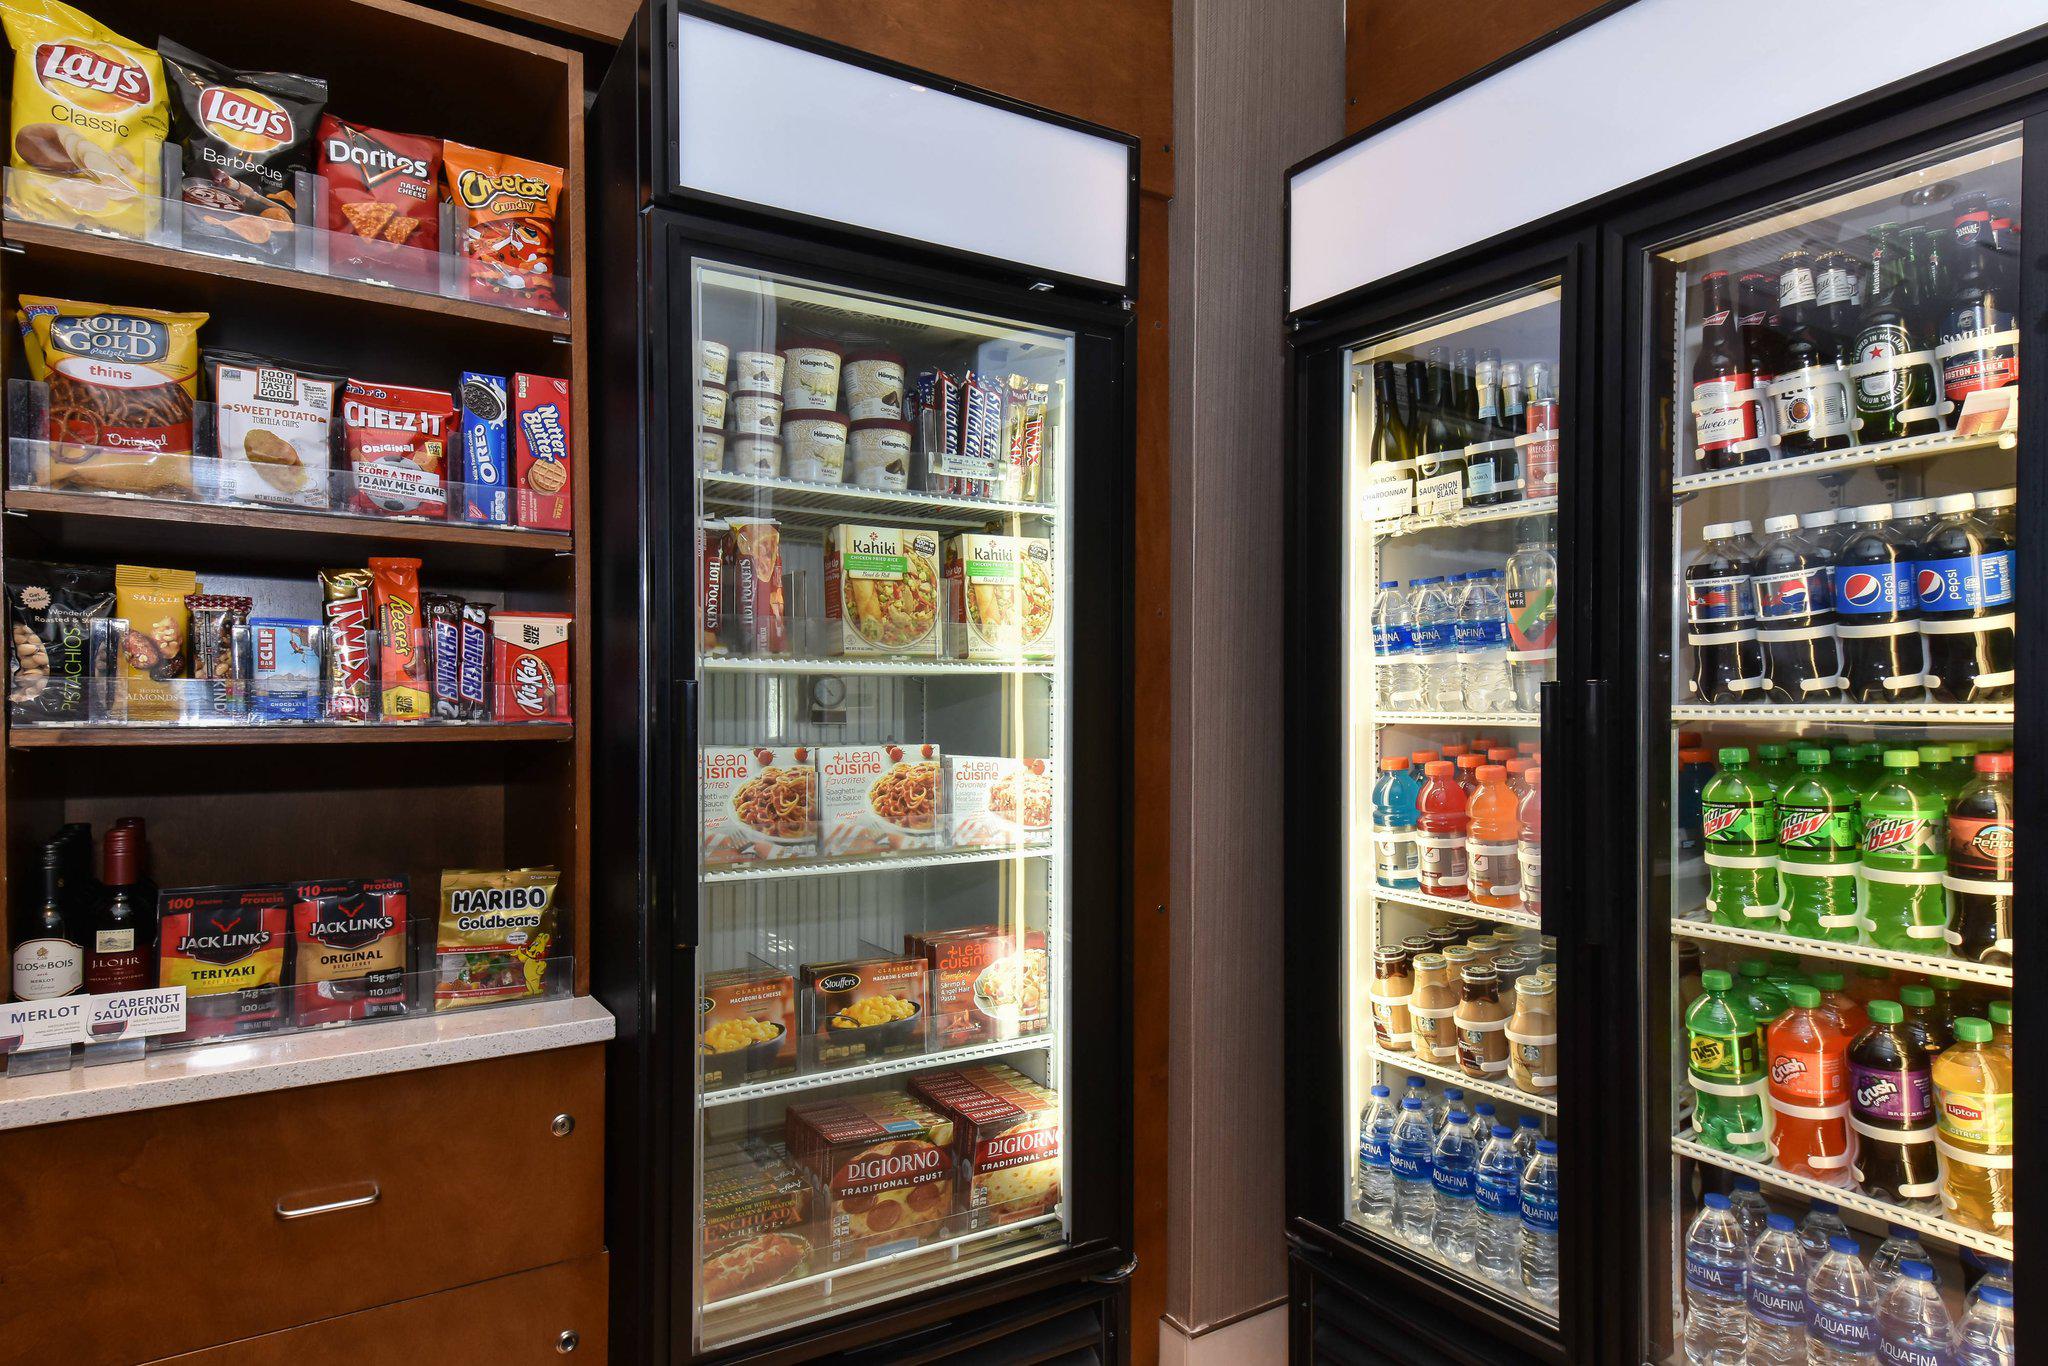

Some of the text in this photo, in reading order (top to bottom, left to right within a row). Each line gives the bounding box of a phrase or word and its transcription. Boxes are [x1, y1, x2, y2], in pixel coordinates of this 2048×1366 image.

[42, 45, 144, 94] Lay's
[51, 104, 130, 138] Classic
[206, 91, 287, 135] Lay's
[203, 147, 283, 181] Barbecue
[329, 140, 428, 178] Doritos
[397, 187, 428, 199] CHEESE
[400, 181, 427, 193] NACHO
[460, 170, 548, 204] Cheetos
[490, 200, 535, 213] Crunchy
[1956, 222, 1981, 234] SAMUEL
[1871, 260, 1881, 295] Heineken
[74, 316, 152, 336] ROLD
[61, 330, 158, 358] GOLD
[1869, 333, 1905, 352] IN HOLLAND
[90, 347, 126, 359] Pretzels
[89, 365, 133, 380] thins
[261, 370, 293, 380] FOOD
[1973, 361, 2006, 376] LAGER
[261, 376, 293, 386] SHOULD
[261, 382, 292, 391] TASTE
[261, 389, 292, 399] GOOD
[374, 390, 386, 399] Go
[808, 396, 828, 404] VANILLA
[234, 404, 317, 423] SWEET POTATO
[344, 401, 443, 436] CHEEZ-IT
[252, 416, 300, 428] TORTILLA CHIPS
[523, 411, 554, 463] Butter
[538, 405, 567, 458] Nutter
[107, 433, 169, 450] Original
[1026, 416, 1044, 466] TWIX
[468, 446, 477, 466] Favorite
[473, 424, 498, 484] OREO
[358, 467, 422, 483] SCORE A TRIP
[358, 475, 445, 497] TO ANY MLS GAME
[1419, 480, 1459, 496] SAUVIGNON
[1437, 488, 1459, 499] BLANC
[1363, 487, 1409, 502] CHARDONNAY
[853, 540, 896, 555] Kahiki
[974, 547, 1014, 561] Kahiki
[1882, 572, 1894, 604] pepsi
[1945, 569, 1962, 601] pepsi
[132, 593, 181, 604] SAHALE
[707, 561, 721, 629] HOT POCKETS
[49, 609, 94, 617] Wonderful
[389, 594, 415, 657] Reese's
[523, 624, 532, 643] KING
[326, 586, 371, 691] TWIX
[531, 625, 540, 645] SIZE
[260, 628, 274, 662] CLIF
[60, 627, 83, 711] PISTACHIOS
[436, 622, 459, 700] SNICKERS
[463, 624, 485, 700] SNICKERS
[127, 693, 179, 701] ALMONDS
[213, 680, 228, 712] KIND
[707, 752, 747, 767] Lean
[845, 751, 881, 764] Lean
[971, 761, 999, 772] Lean
[825, 776, 867, 788] favorites
[826, 788, 856, 796] Spaghetti
[842, 794, 863, 802] Sauce
[1989, 830, 2007, 841] Dr
[297, 886, 320, 897] 110
[363, 881, 404, 892] Protein
[168, 898, 194, 911] 100
[240, 894, 284, 905] Protein
[452, 887, 547, 914] HARIBO
[309, 916, 394, 937] JACK LINK'S
[458, 915, 540, 931] Goldbears
[178, 931, 271, 951] JACK LINK'S
[16, 959, 74, 972] CLOS BOIS
[320, 949, 384, 966] ORIGINAL
[191, 966, 256, 980] TERIYAKI
[872, 971, 919, 982] MACARONI CHEESE
[877, 965, 914, 975] CLASSICS
[940, 970, 972, 981] Comfort
[368, 974, 385, 983] 15g
[824, 976, 857, 989] Stouffer's
[940, 980, 961, 989] Shrimp
[369, 988, 384, 997] 110
[729, 991, 782, 1005] MACARONI CHEESE
[941, 988, 958, 996] Angel
[109, 993, 181, 1010] CABERNET
[241, 1003, 258, 1013] 100
[11, 1005, 80, 1025] MERLOT
[94, 1003, 180, 1021] SAUVIGNON
[1771, 1059, 1807, 1085] Crush
[1856, 1079, 1898, 1108] Crush
[959, 1098, 1000, 1108] DIGIORNO
[972, 1106, 1014, 1118] DIGIORNO
[1947, 1105, 1979, 1119] Lipton
[831, 1126, 878, 1139] DIGIORNO
[1950, 1128, 1983, 1140] CITRUS
[848, 1150, 940, 1181] DIGIORNO
[981, 1153, 1041, 1171] TRADITIONAL
[841, 1171, 943, 1197] TRADITIONAL CRUST
[1433, 1170, 1469, 1188] AQUAFINA
[704, 1206, 801, 1244] ENCHILADA
[1753, 1288, 1805, 1314] AQUAFINA
[1814, 1313, 1871, 1341] AQUAFINA
[1879, 1338, 1939, 1366] AQUAFINA
